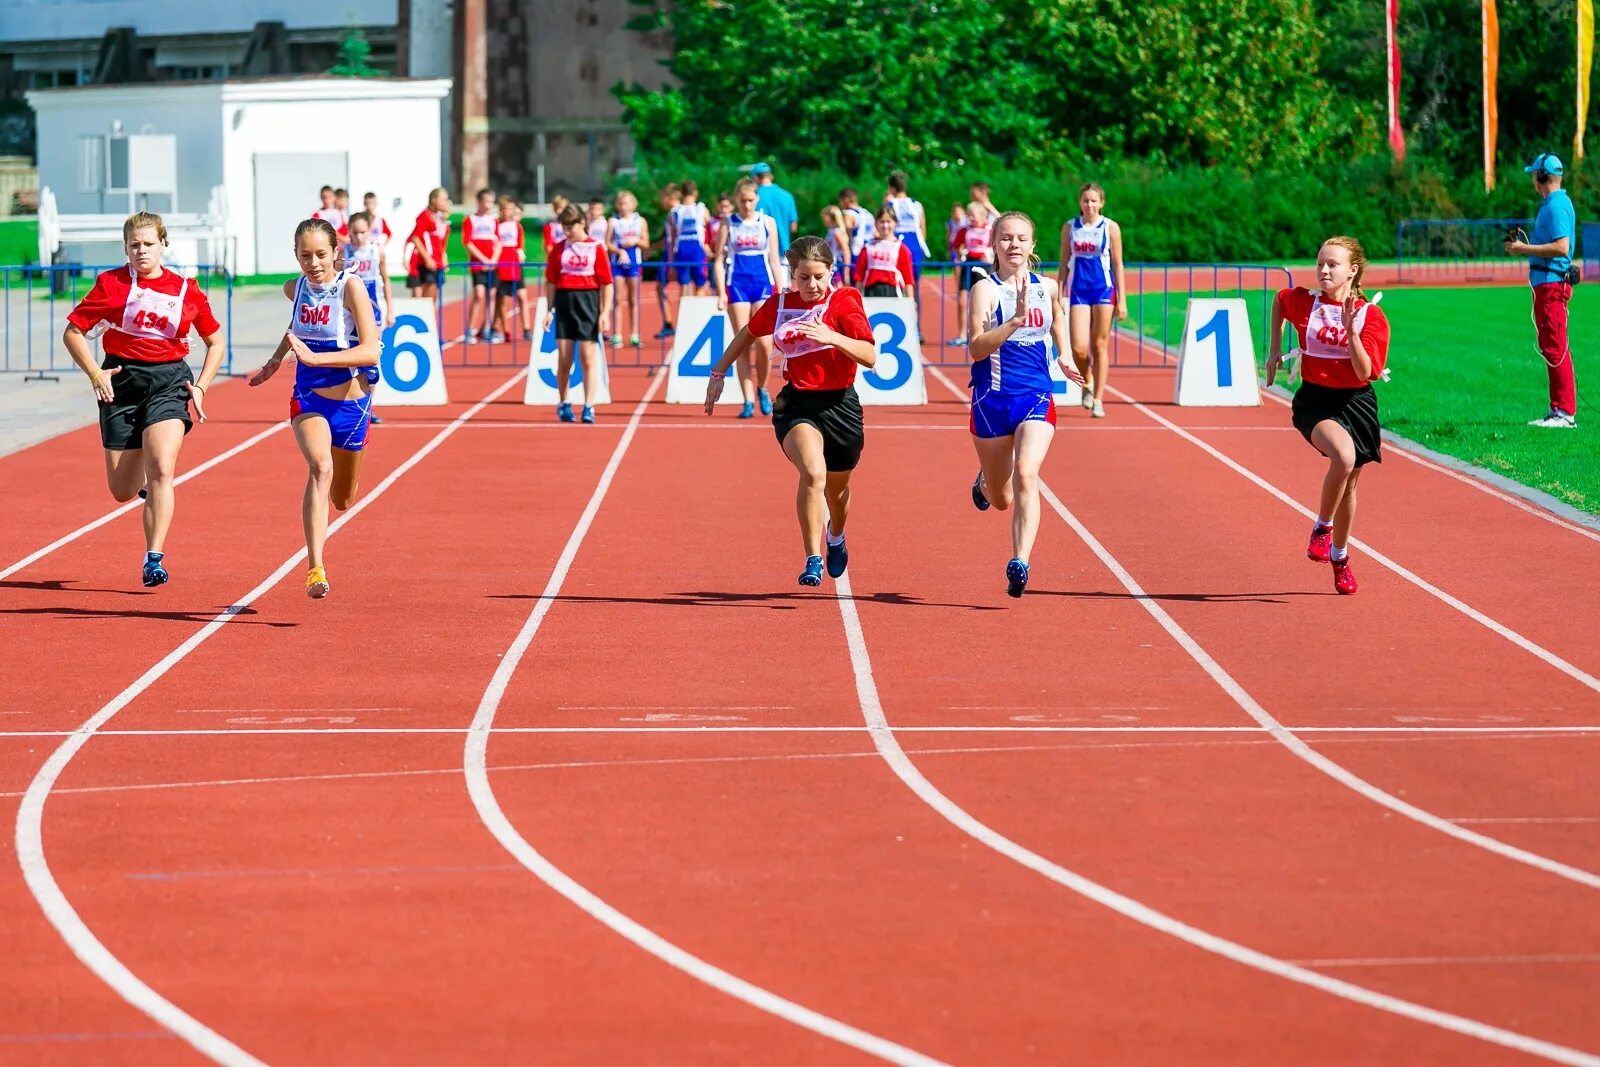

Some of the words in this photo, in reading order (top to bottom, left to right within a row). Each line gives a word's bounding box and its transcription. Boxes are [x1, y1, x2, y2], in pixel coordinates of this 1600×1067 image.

[133, 310, 169, 331] 434
[300, 303, 330, 325] 504
[1020, 307, 1044, 328] 10
[381, 314, 430, 392] 6
[678, 316, 733, 376] 4
[863, 312, 913, 390] 3
[1196, 310, 1232, 387] 1
